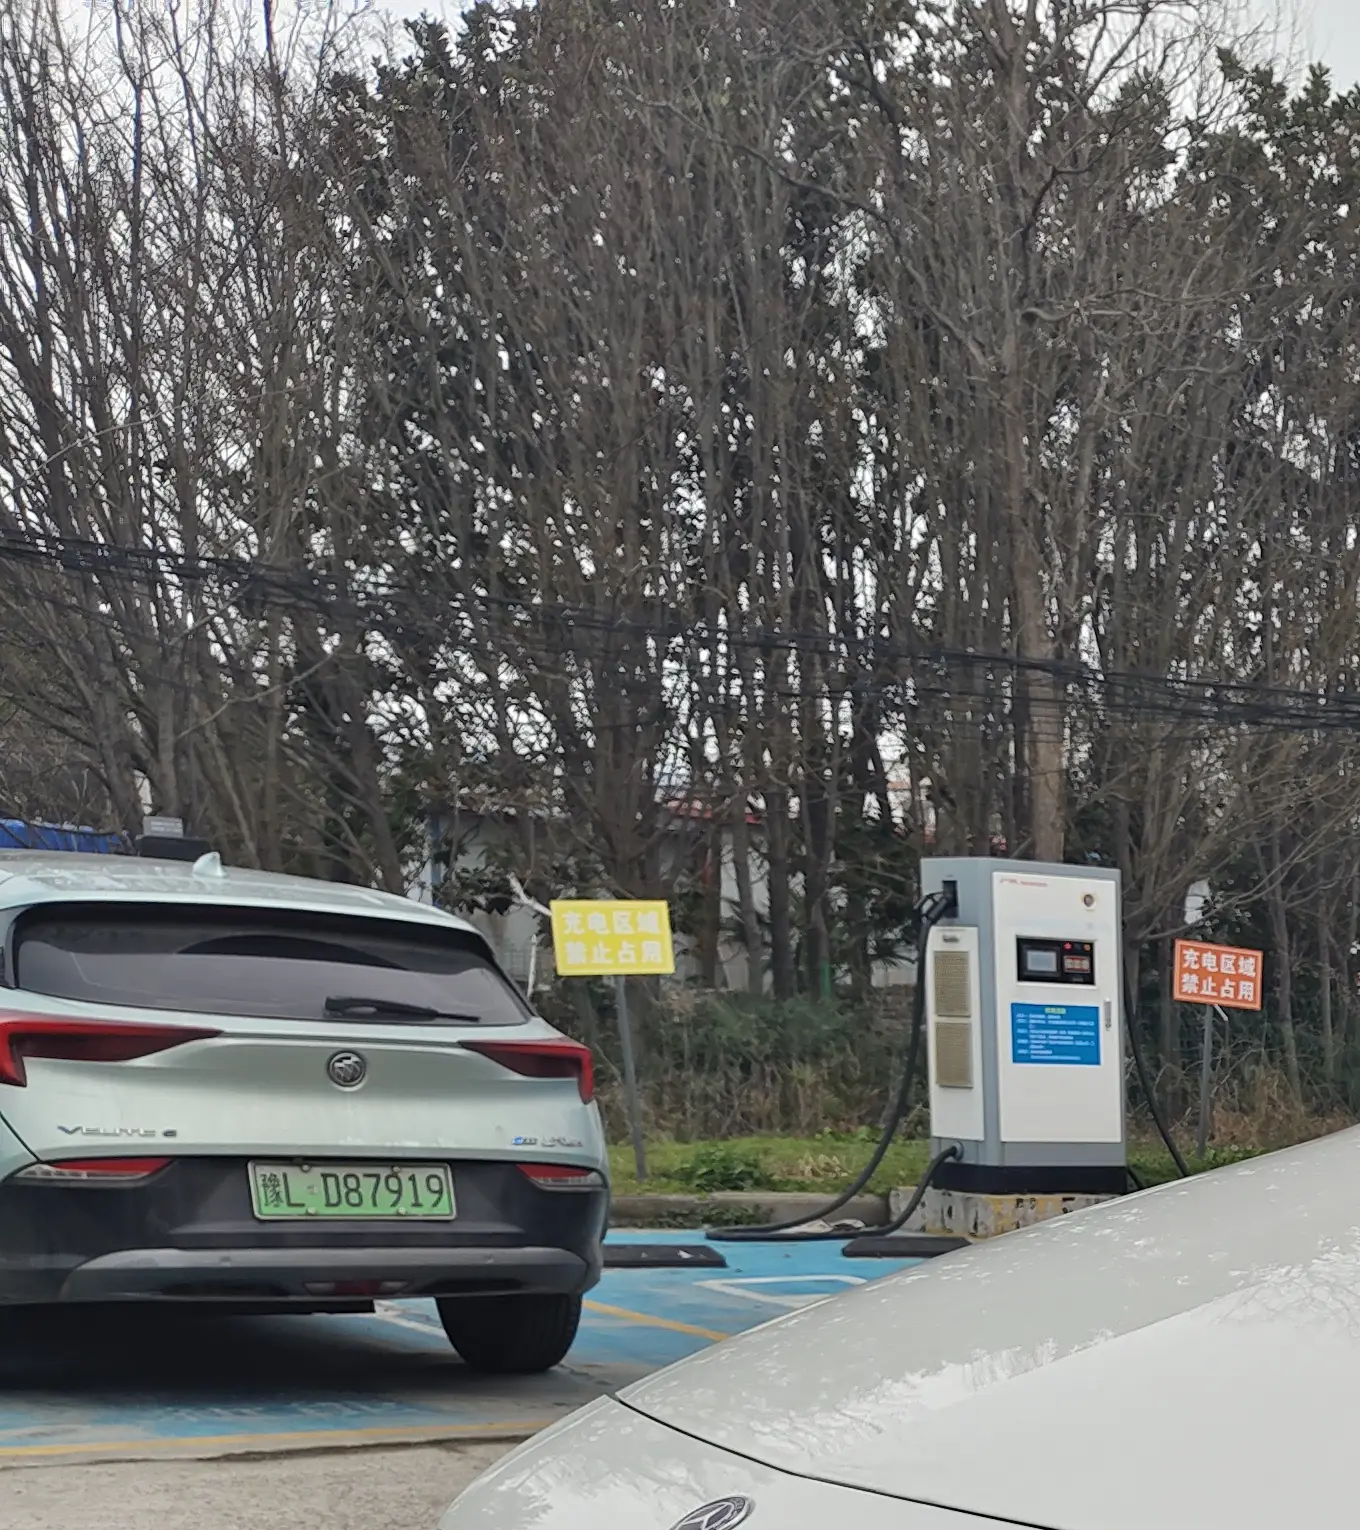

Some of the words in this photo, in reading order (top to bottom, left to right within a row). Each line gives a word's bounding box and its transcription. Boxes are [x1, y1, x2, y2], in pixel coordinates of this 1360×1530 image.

[1182, 948, 1256, 977] 充电区域
[1181, 972, 1254, 1002] 禁止占用
